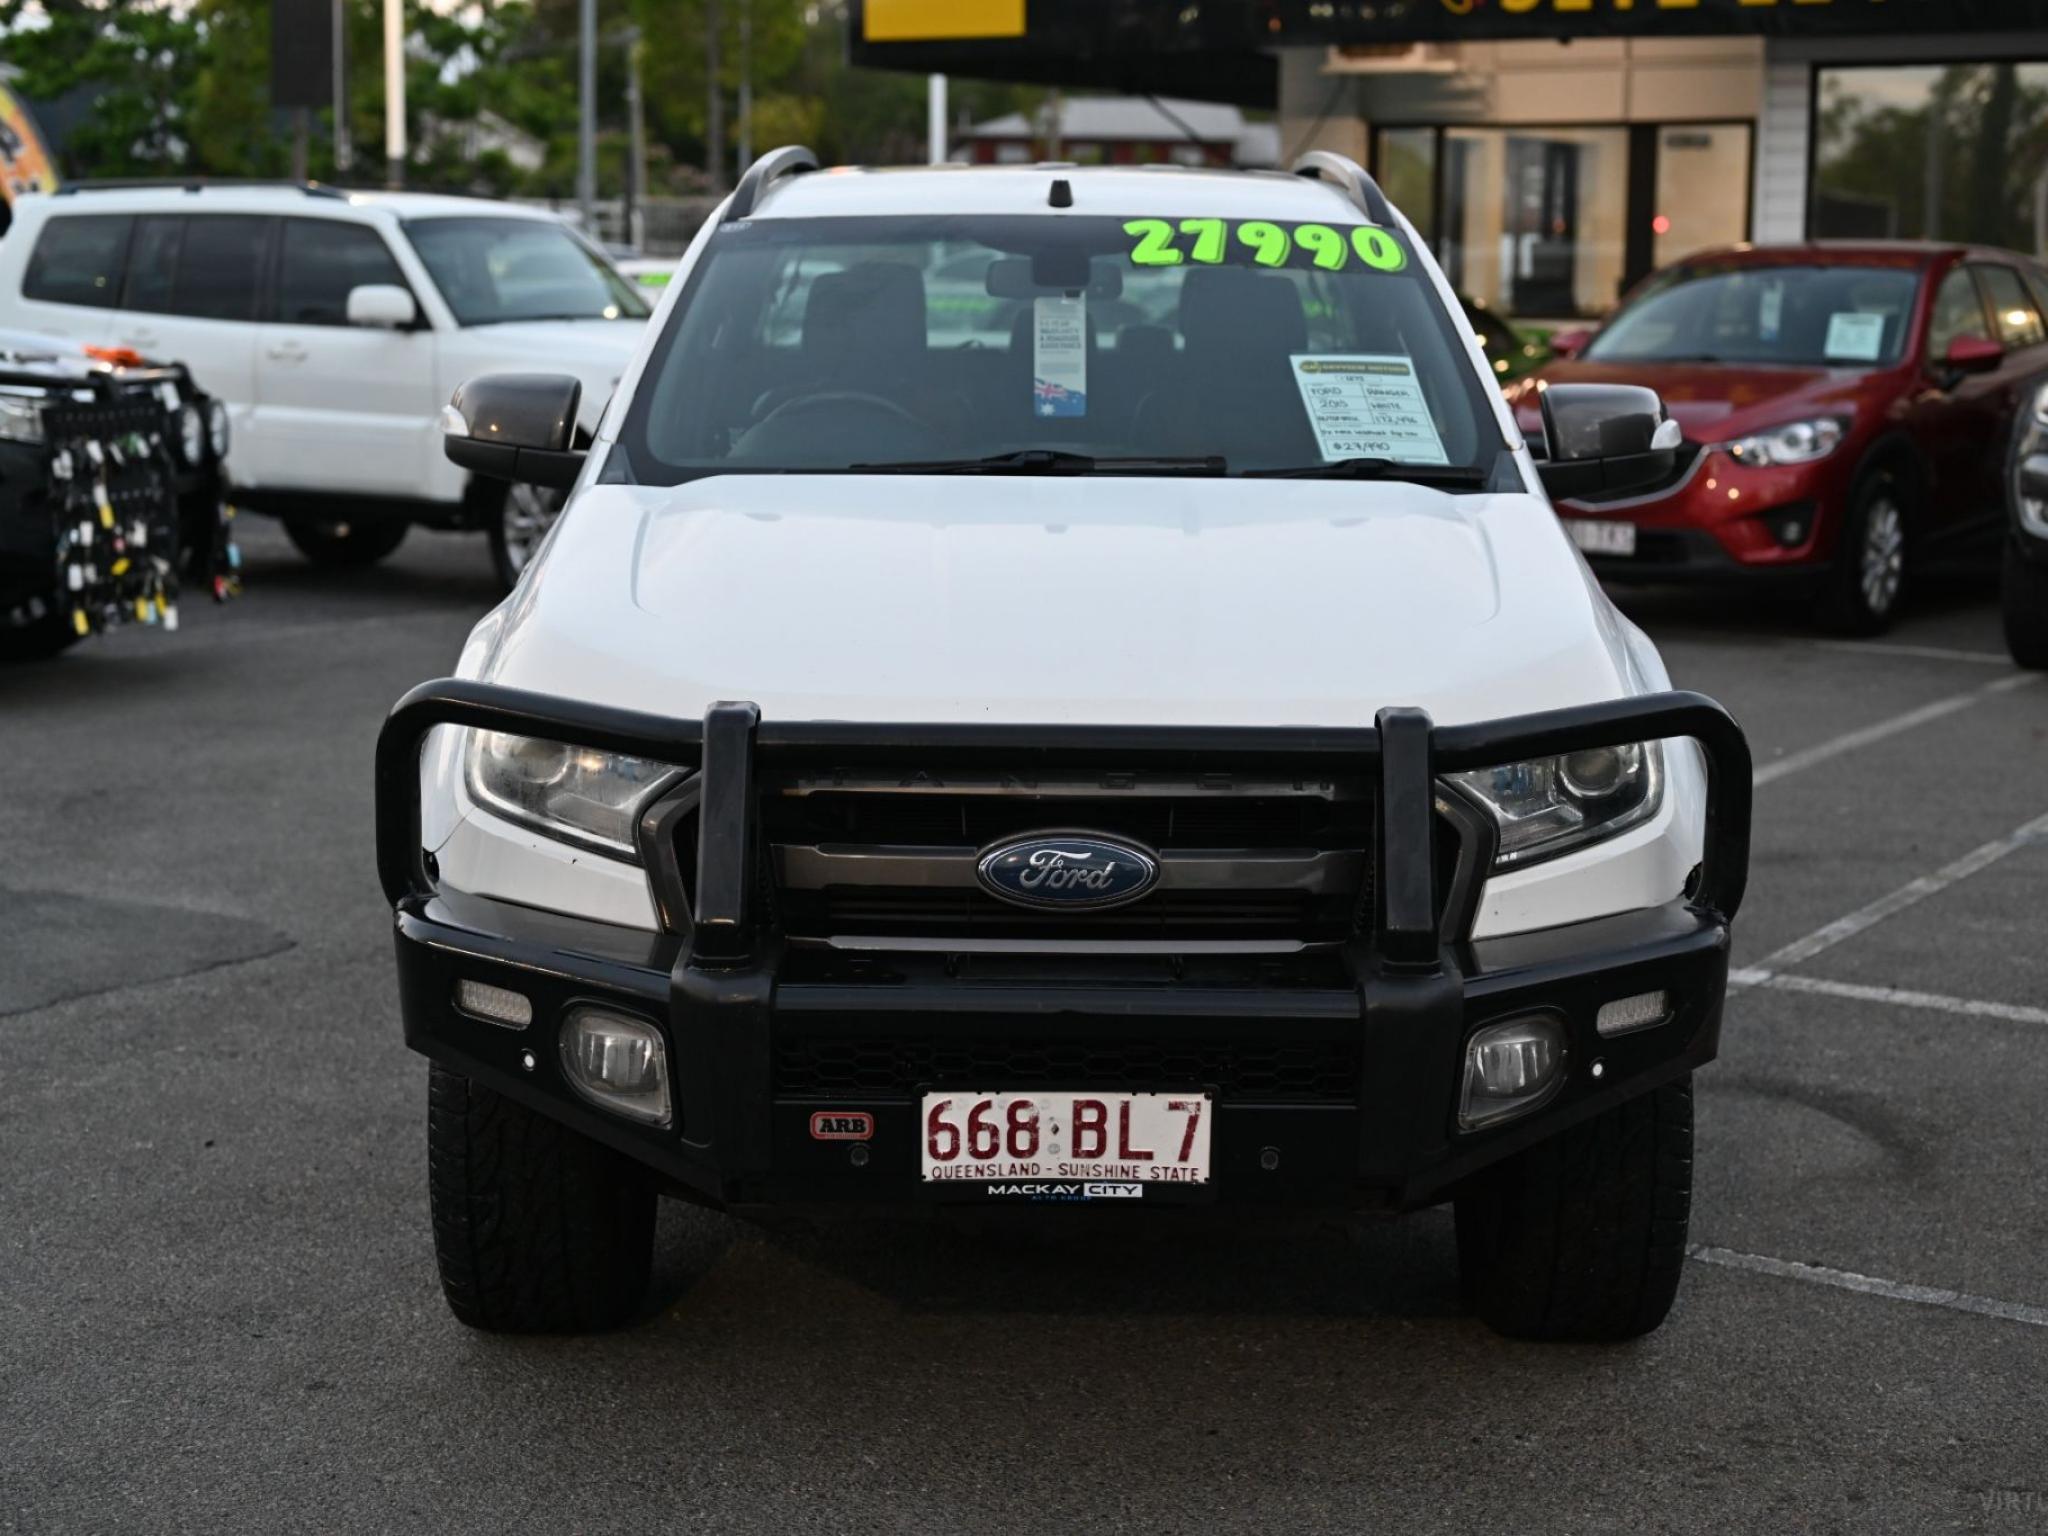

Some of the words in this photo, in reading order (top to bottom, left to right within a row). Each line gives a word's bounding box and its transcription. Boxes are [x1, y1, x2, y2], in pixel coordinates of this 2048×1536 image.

[1122, 218, 1407, 272] 27990
[1020, 849, 1116, 890] Ford
[819, 1118, 867, 1134] ARB
[931, 1163, 1041, 1180] QUEENSLAND
[1058, 1164, 1141, 1180] SUNSHINE
[1150, 1166, 1199, 1182] STATE
[988, 1185, 1080, 1195] MACKAY
[1088, 1185, 1138, 1195] CITY
